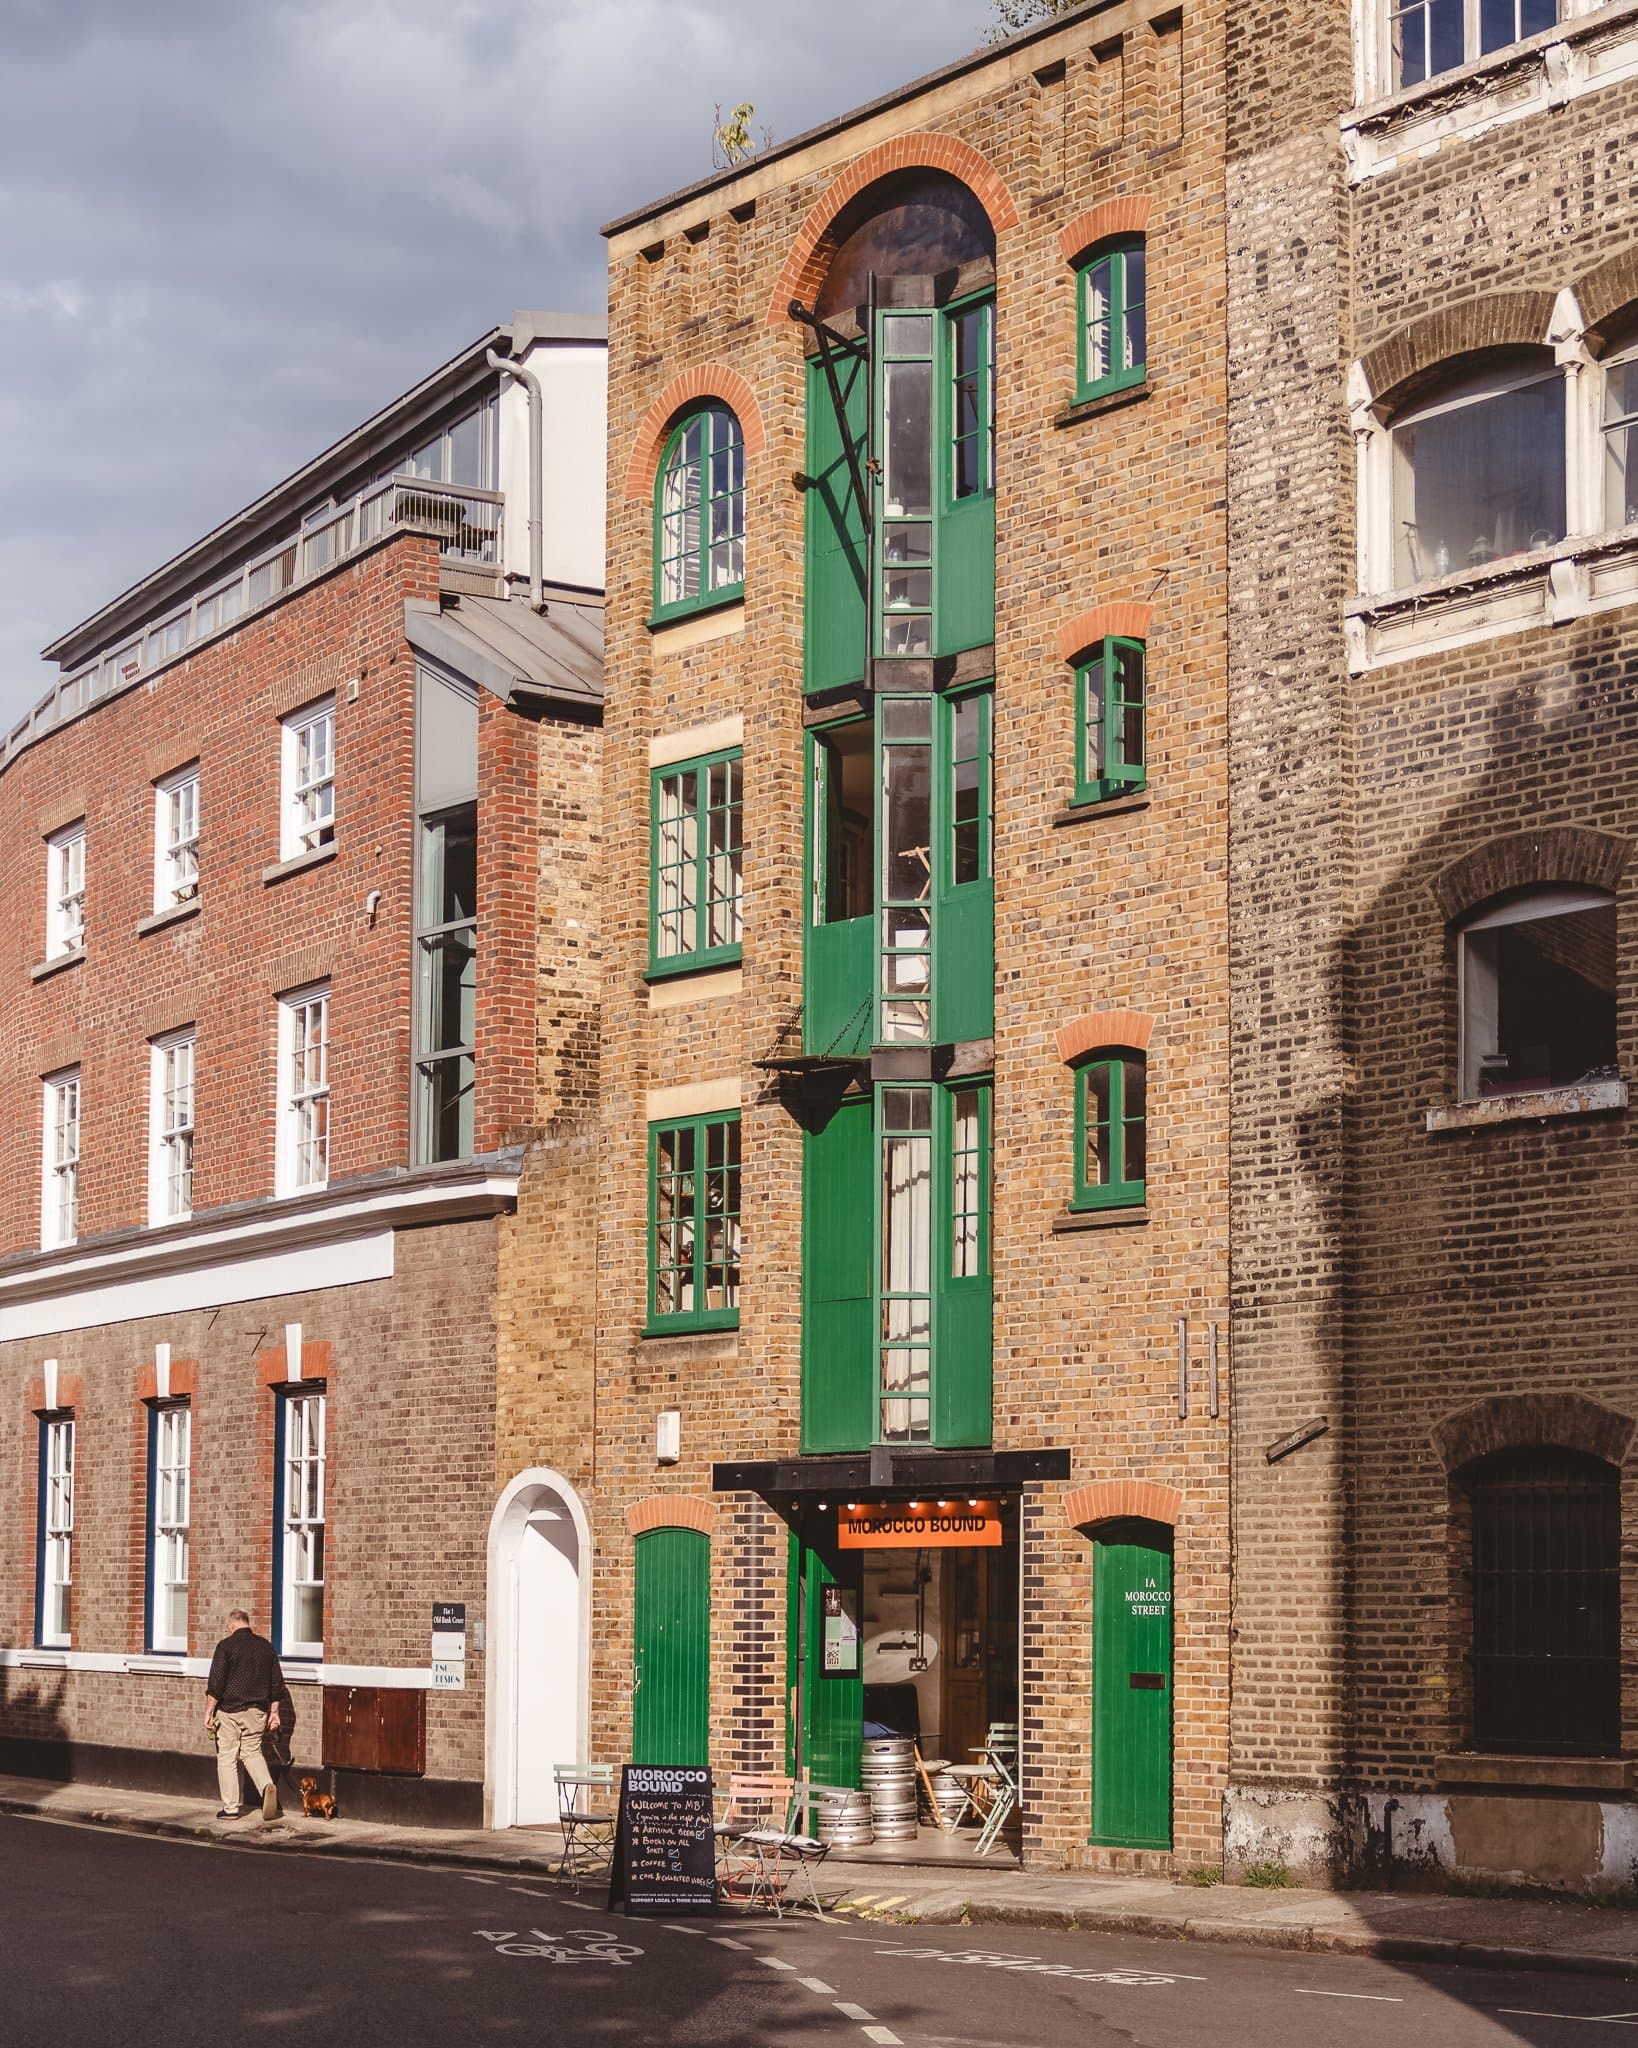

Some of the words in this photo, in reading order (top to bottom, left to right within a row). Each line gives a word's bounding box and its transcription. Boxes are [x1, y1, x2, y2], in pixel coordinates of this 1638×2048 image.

[848, 1517, 925, 1534] MOROCCO
[930, 1515, 985, 1532] BOUND
[1125, 1591, 1171, 1602] MOROCCO
[1131, 1604, 1166, 1616] STREET
[627, 1769, 707, 1783] MOROCCO
[628, 1780, 683, 1793] BOUND
[631, 1800, 669, 1810] WELCOME
[671, 1802, 682, 1810] TO
[640, 1859, 667, 1868] COFFEE
[874, 1948, 1176, 1985] DISABLED
